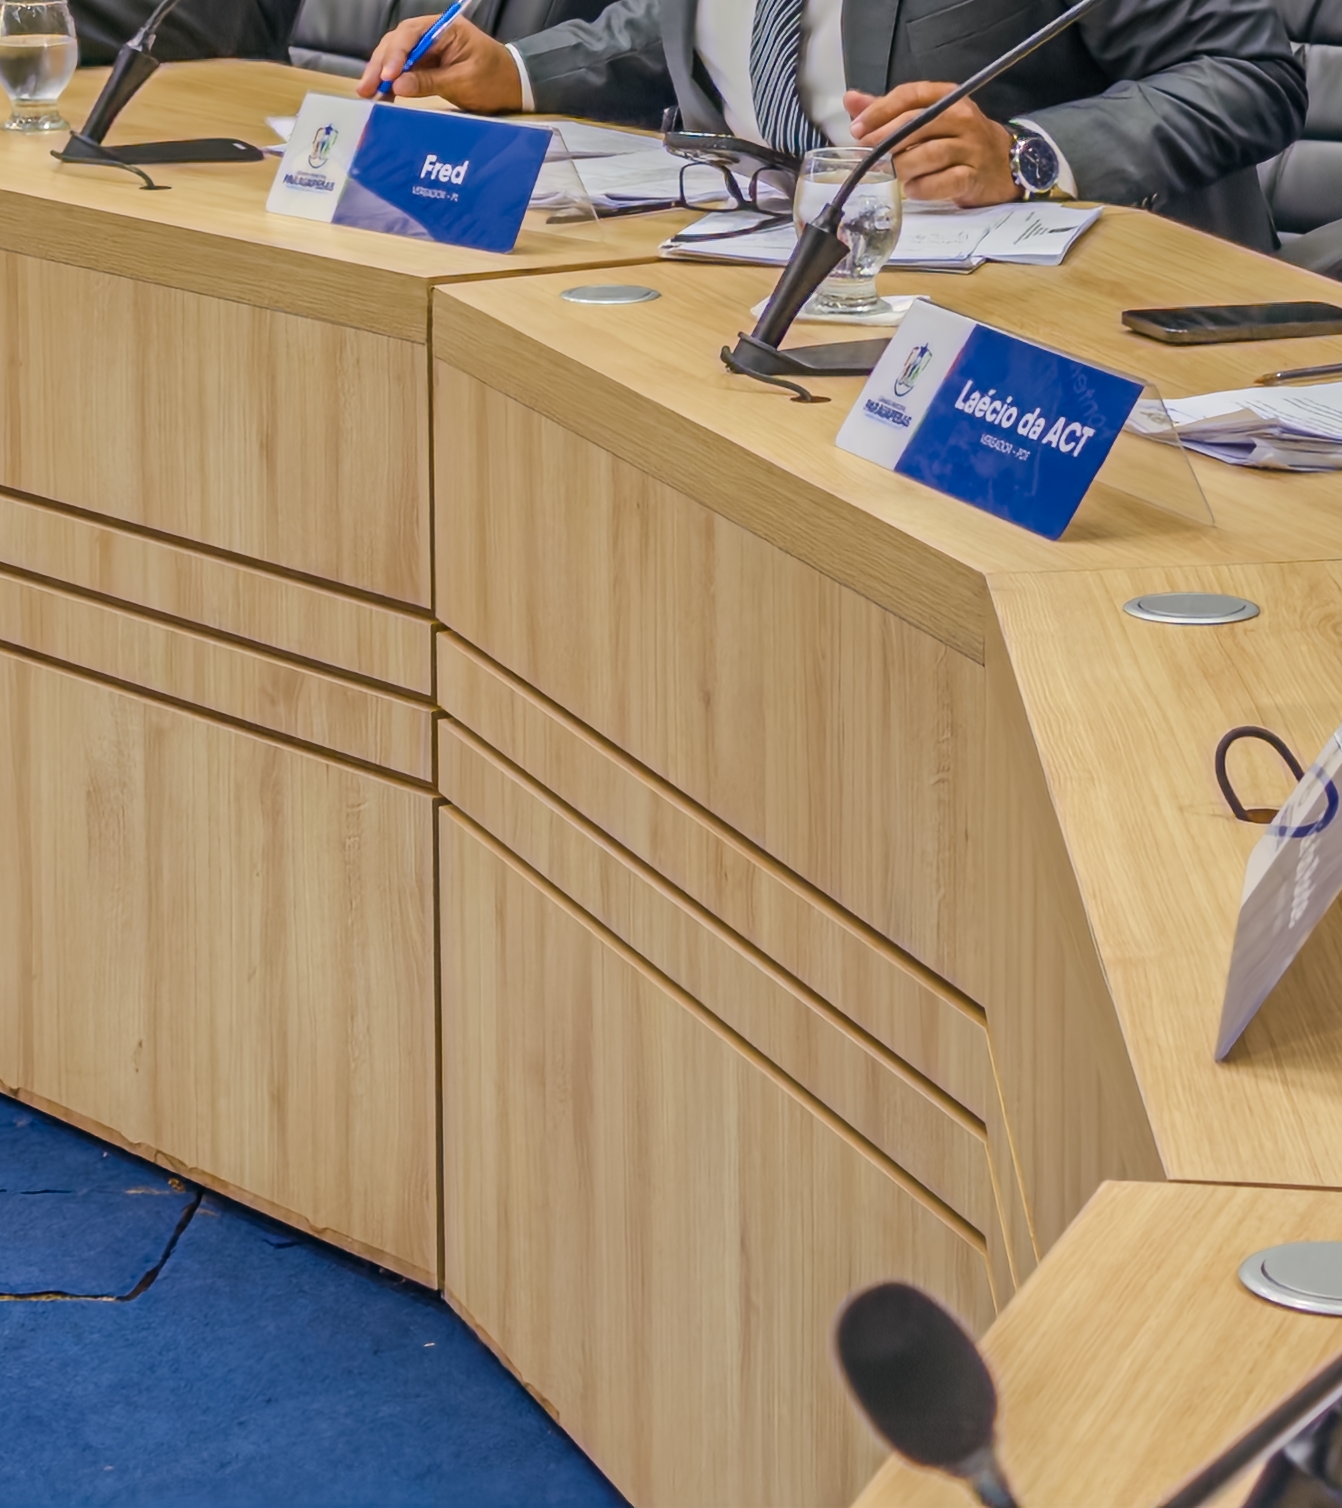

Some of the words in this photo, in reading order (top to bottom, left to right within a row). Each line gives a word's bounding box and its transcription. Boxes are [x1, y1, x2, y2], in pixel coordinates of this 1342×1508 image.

[420, 154, 470, 185] Fred
[954, 379, 1014, 429] Laécio
[1016, 407, 1046, 441] da
[1041, 416, 1096, 457] ACT
